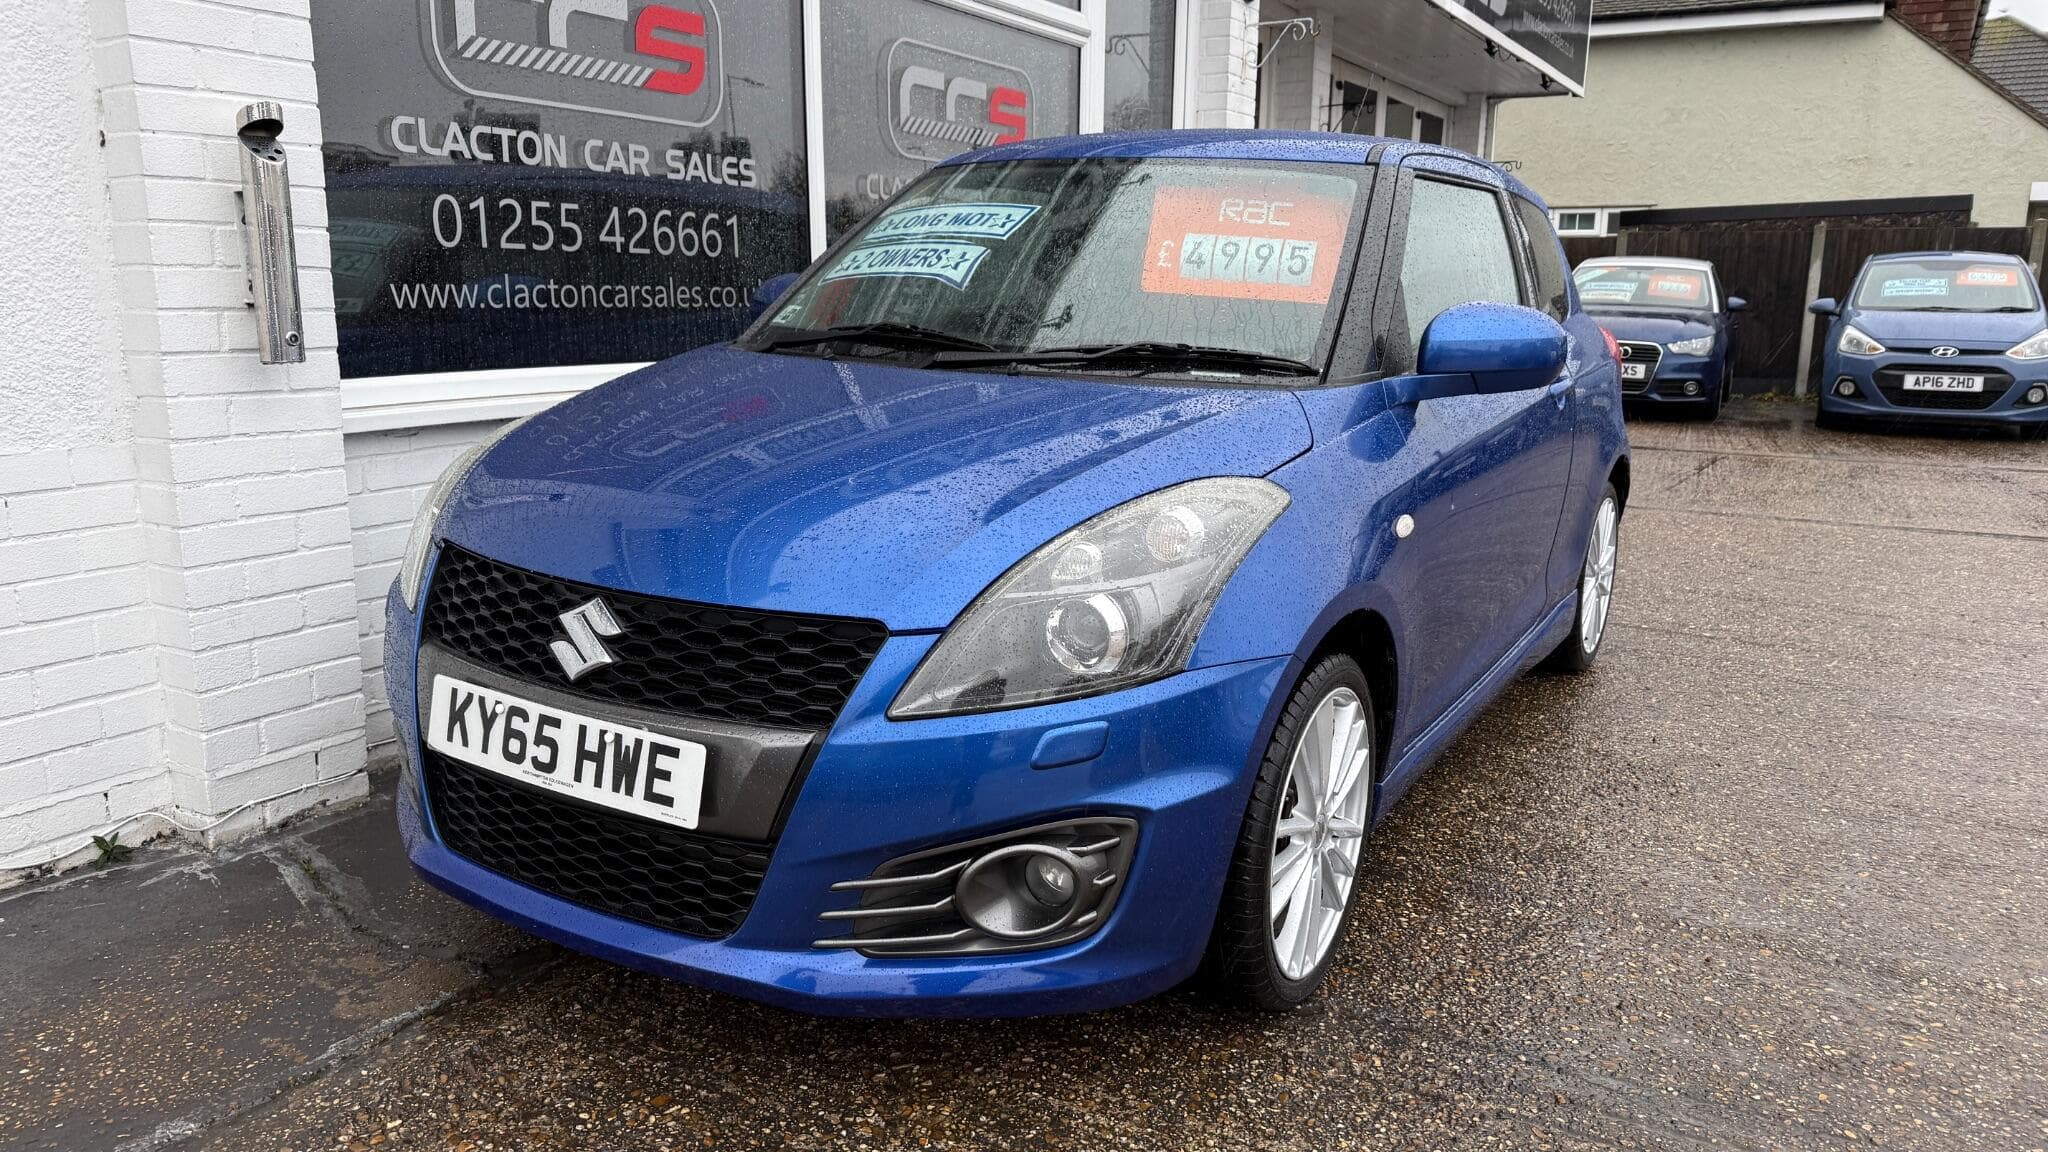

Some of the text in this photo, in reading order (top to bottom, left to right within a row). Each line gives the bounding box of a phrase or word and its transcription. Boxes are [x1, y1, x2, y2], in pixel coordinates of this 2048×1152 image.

[390, 115, 757, 188] CLACTON CAR SALES
[432, 193, 741, 258] 01255 426661
[892, 211, 995, 230] LONG MOT
[867, 248, 950, 269] OWNERS
[390, 273, 762, 309] www.clactoncarsales.co.u
[1913, 376, 1975, 389] AP16 ZHD
[446, 686, 682, 808] KY65 HWE
